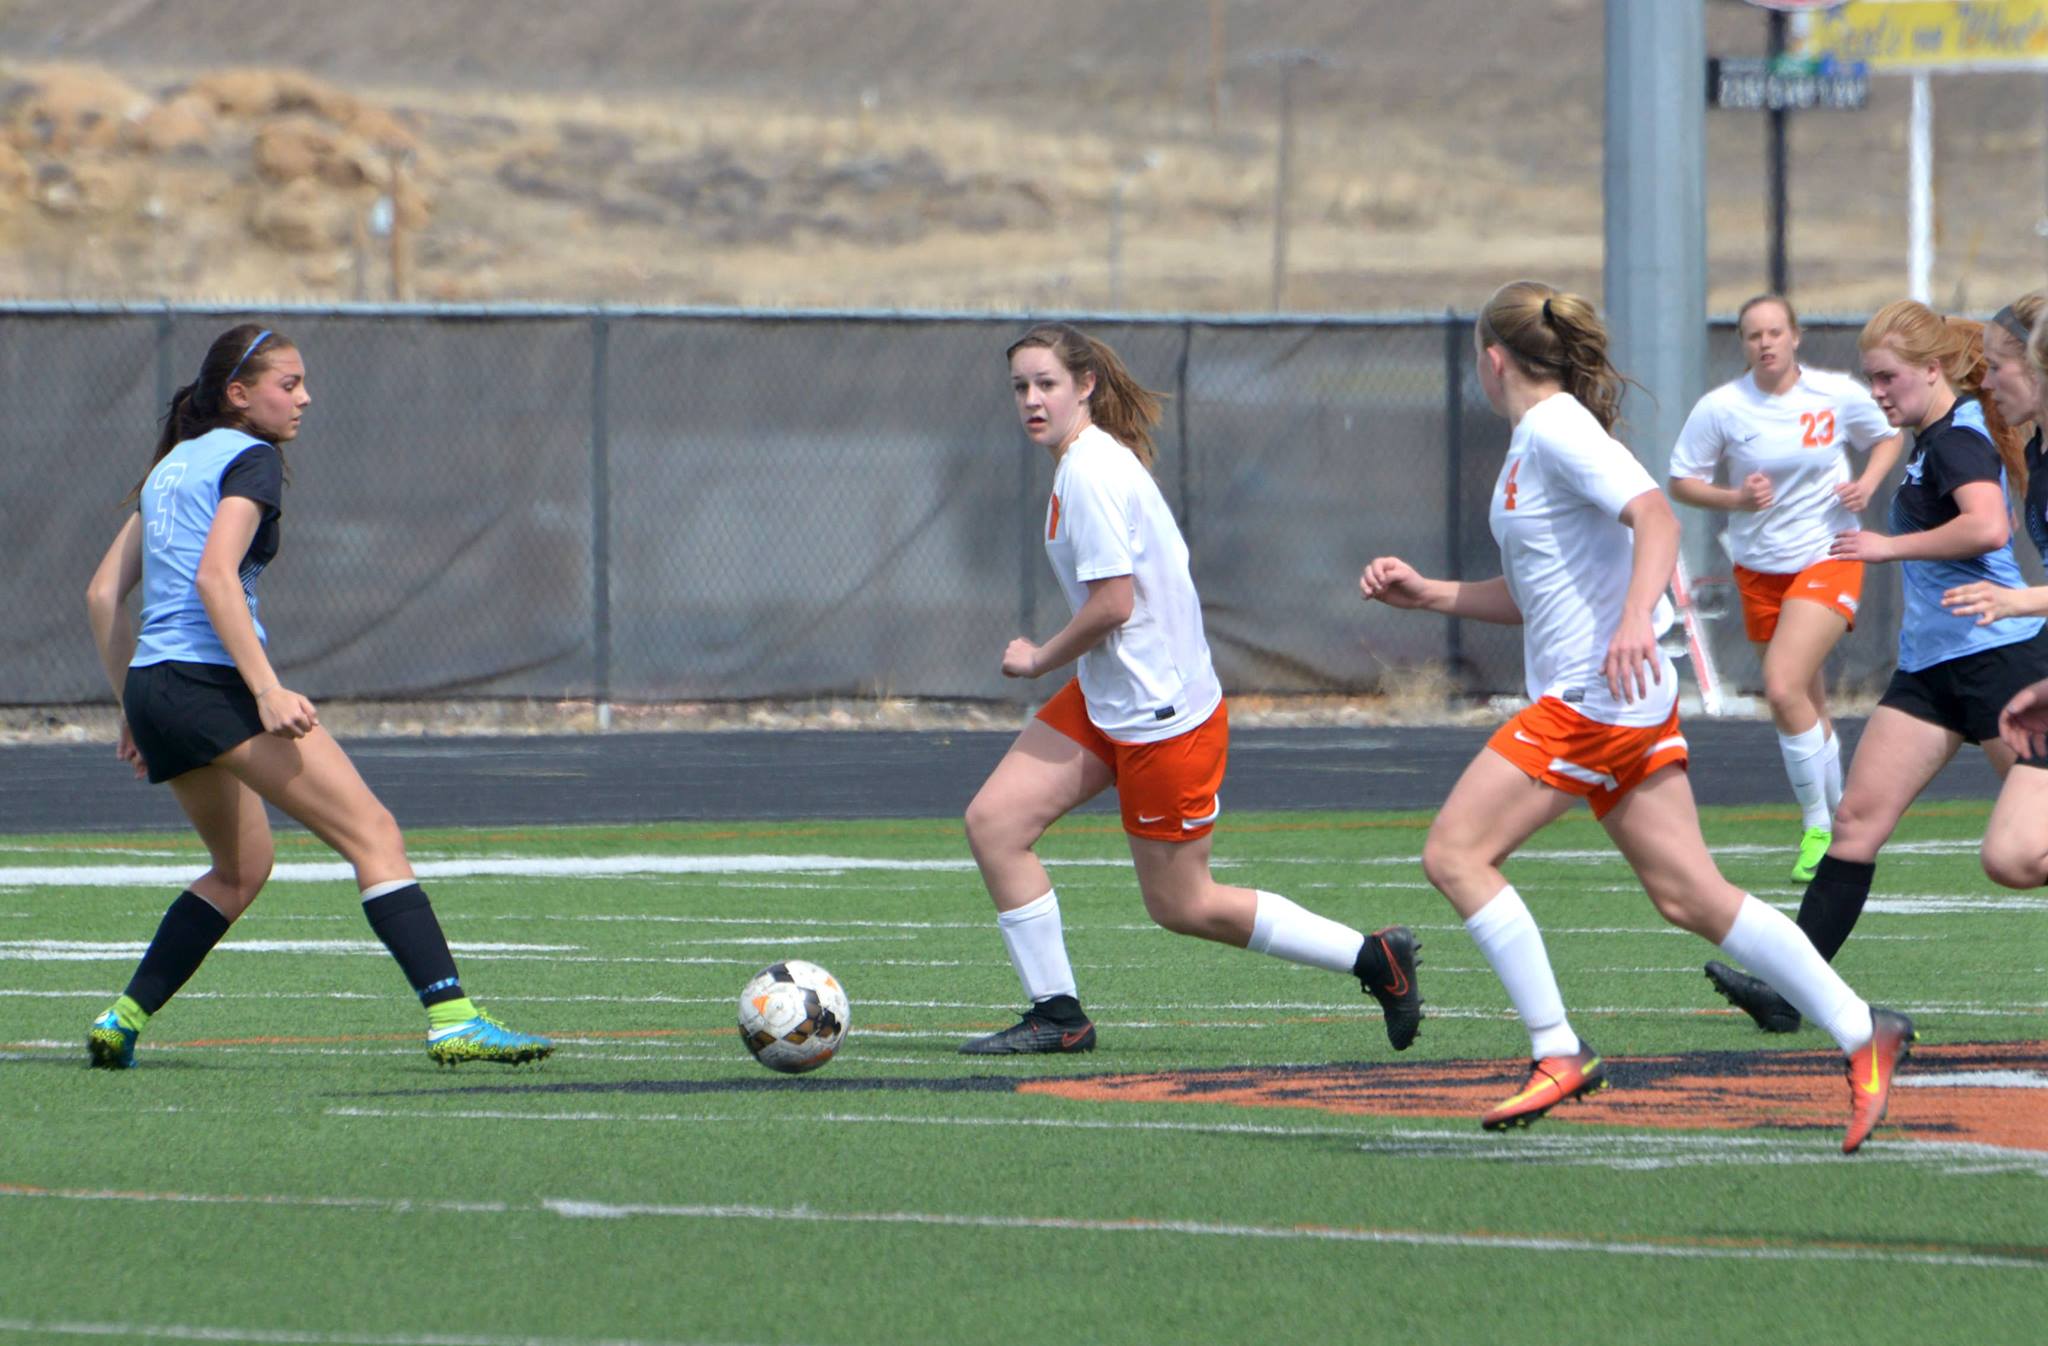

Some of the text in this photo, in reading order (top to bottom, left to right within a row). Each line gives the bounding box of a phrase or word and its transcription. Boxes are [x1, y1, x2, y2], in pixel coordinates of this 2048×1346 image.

[1799, 409, 1837, 449] 23
[146, 461, 188, 554] 3
[1503, 457, 1521, 511] 4
